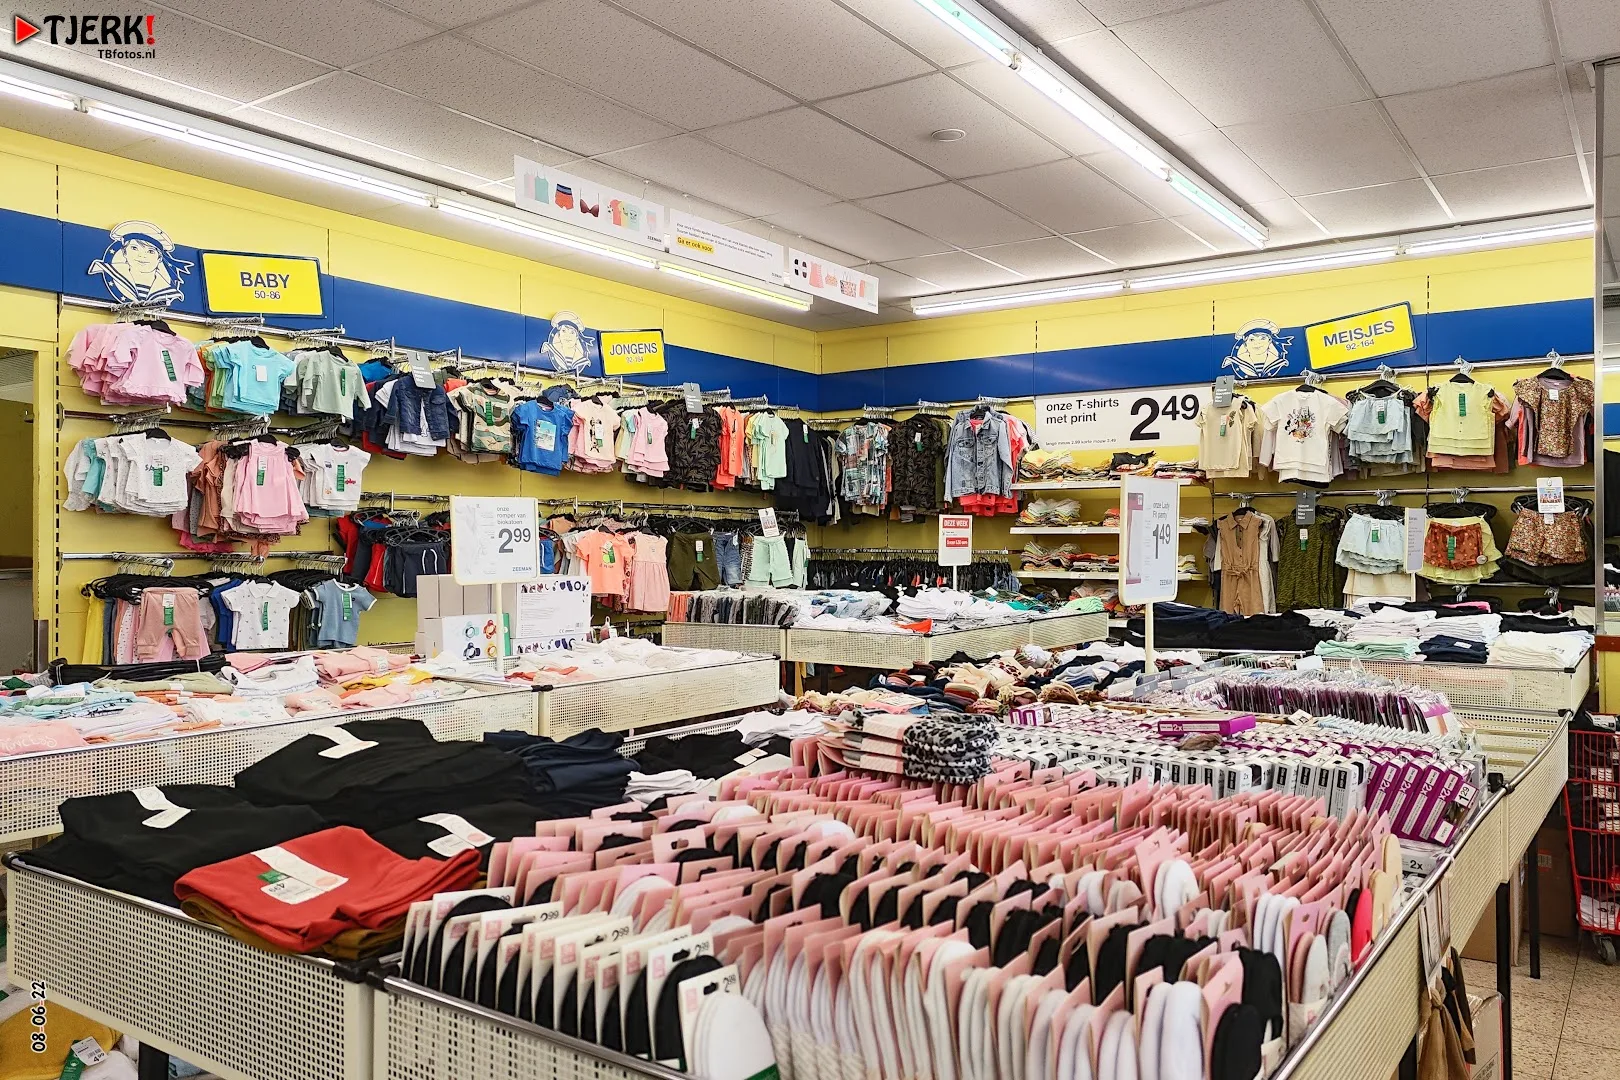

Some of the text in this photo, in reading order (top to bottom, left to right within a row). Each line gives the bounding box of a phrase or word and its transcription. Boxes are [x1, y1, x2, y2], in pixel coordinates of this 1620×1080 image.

[240, 271, 290, 289] BABY
[254, 290, 281, 300] 50-86
[1323, 320, 1396, 347] MEISJES
[609, 342, 658, 356] JONGENS
[1345, 339, 1375, 351] 92-164
[1046, 397, 1119, 412] onze T-shirts
[1046, 411, 1097, 425] met print
[145, 464, 170, 472] SAD
[1400, 780, 1411, 793] 2x
[1420, 783, 1432, 795] 2x
[1439, 787, 1451, 800] 2x
[1410, 859, 1423, 870] 2x
